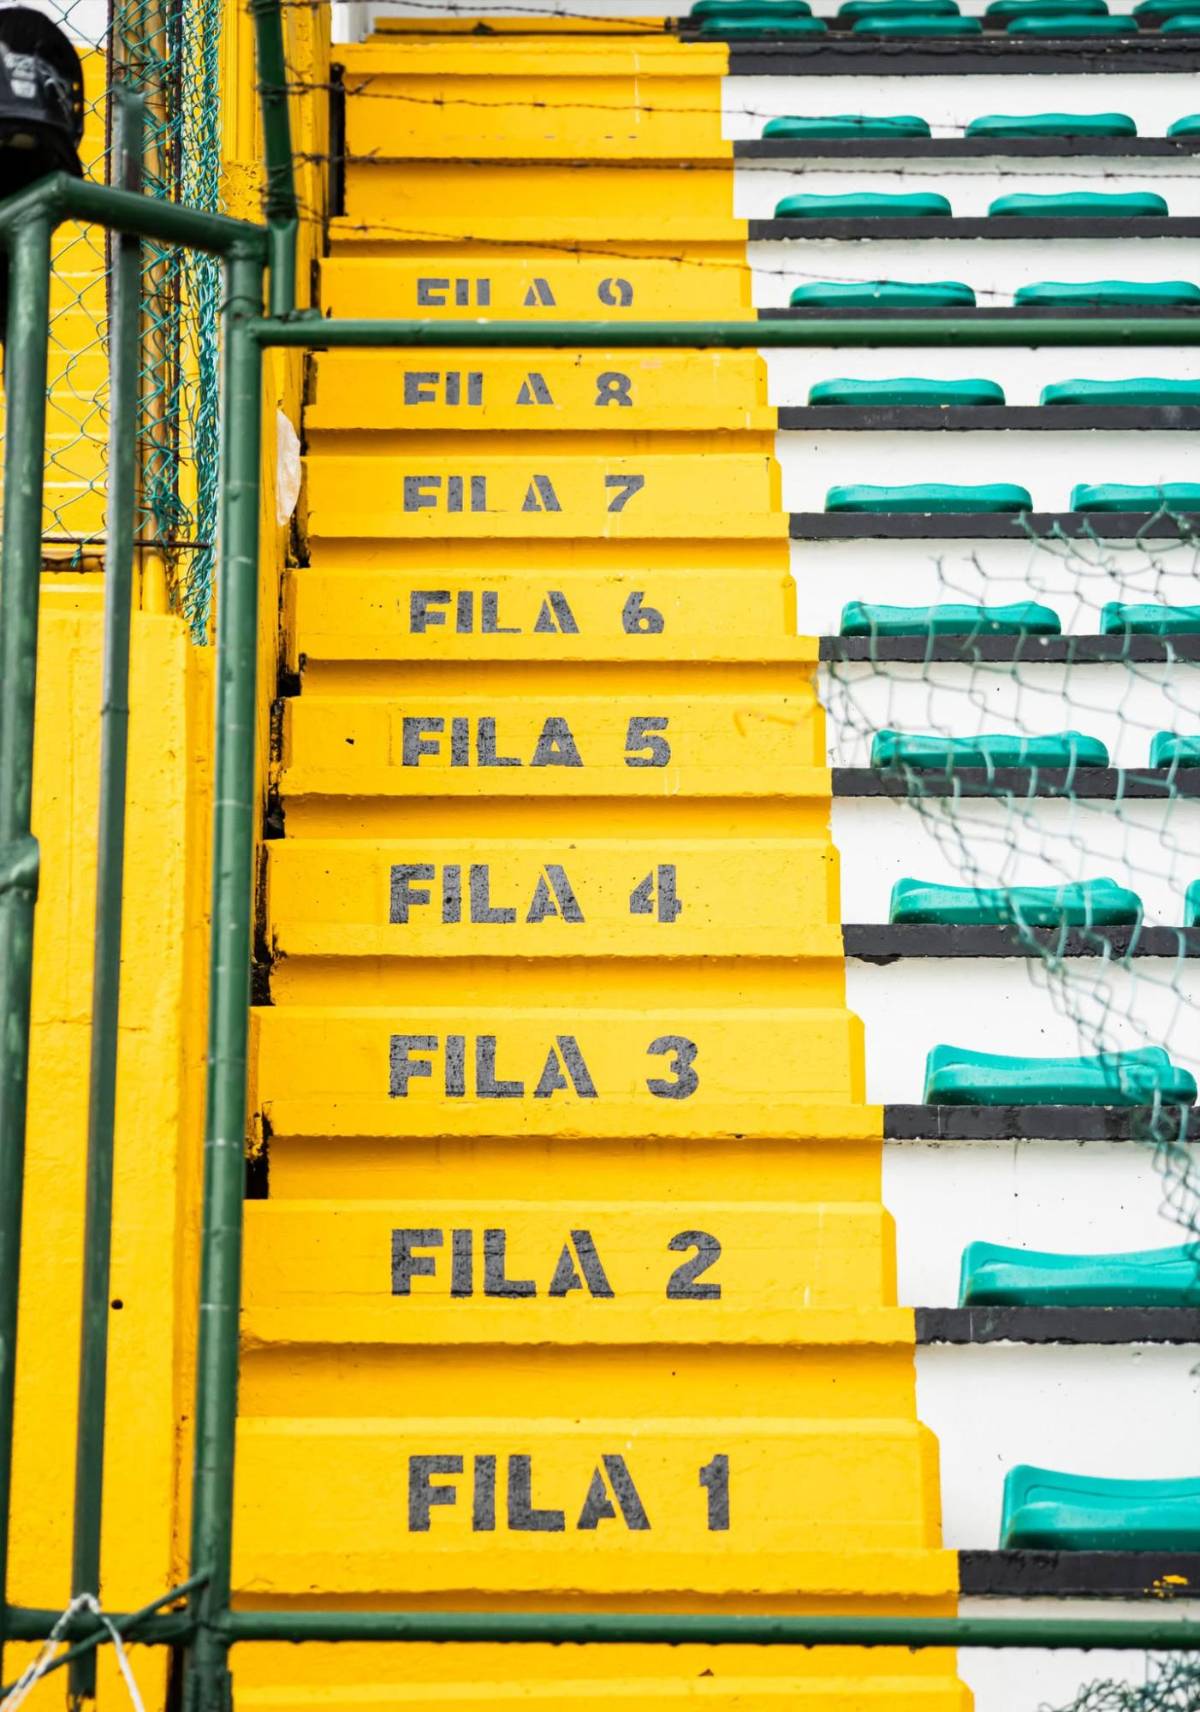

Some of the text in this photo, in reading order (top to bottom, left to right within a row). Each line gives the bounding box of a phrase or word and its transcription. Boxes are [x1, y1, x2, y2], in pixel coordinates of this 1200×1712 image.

[595, 372, 632, 406] 8
[605, 475, 645, 512] 7
[410, 591, 664, 634] FILA 6
[402, 717, 672, 767] FILA 5
[390, 864, 682, 923] FILA 4
[389, 1035, 699, 1099] FILA 3
[392, 1229, 721, 1300] FILA 2
[409, 1454, 729, 1531] FILA 1
